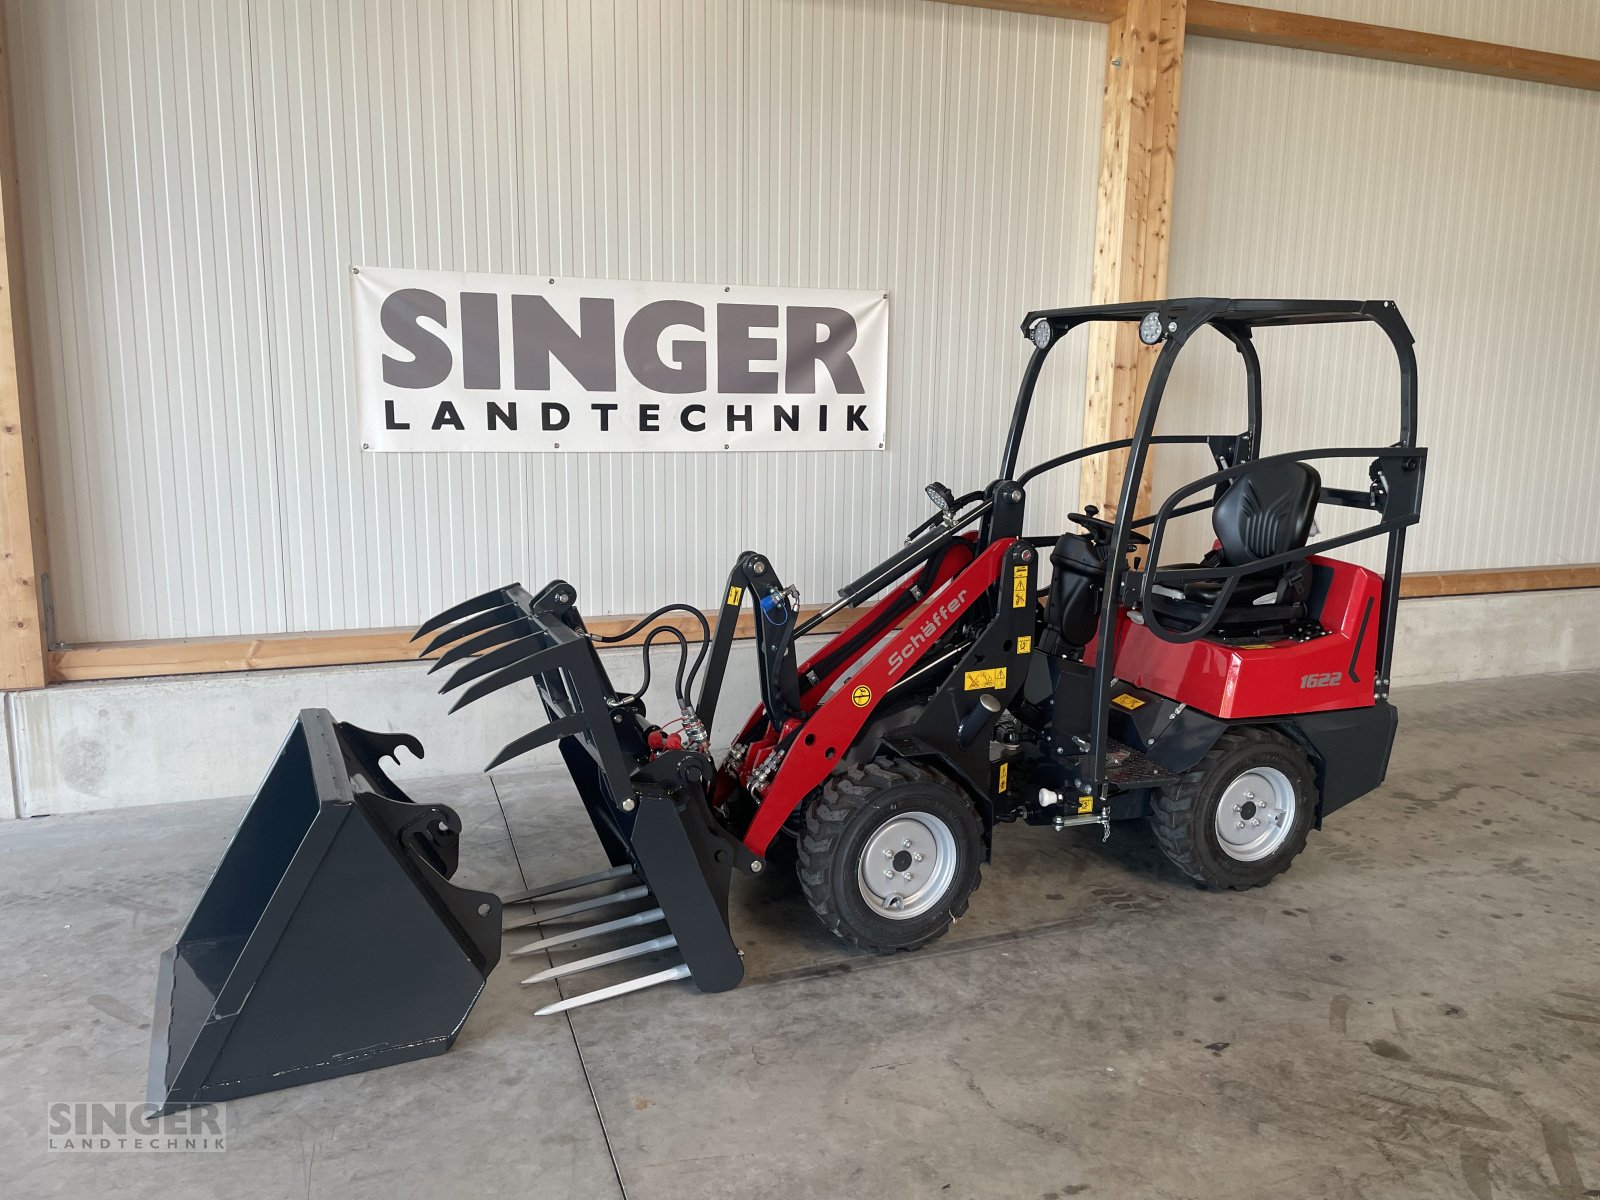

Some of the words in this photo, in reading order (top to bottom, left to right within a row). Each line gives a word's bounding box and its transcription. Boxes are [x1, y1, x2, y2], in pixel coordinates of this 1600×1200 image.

[380, 288, 866, 394] SINGER
[385, 400, 870, 433] LANDTECHNIK
[888, 589, 968, 676] Schäffer
[1301, 672, 1342, 689] 1622
